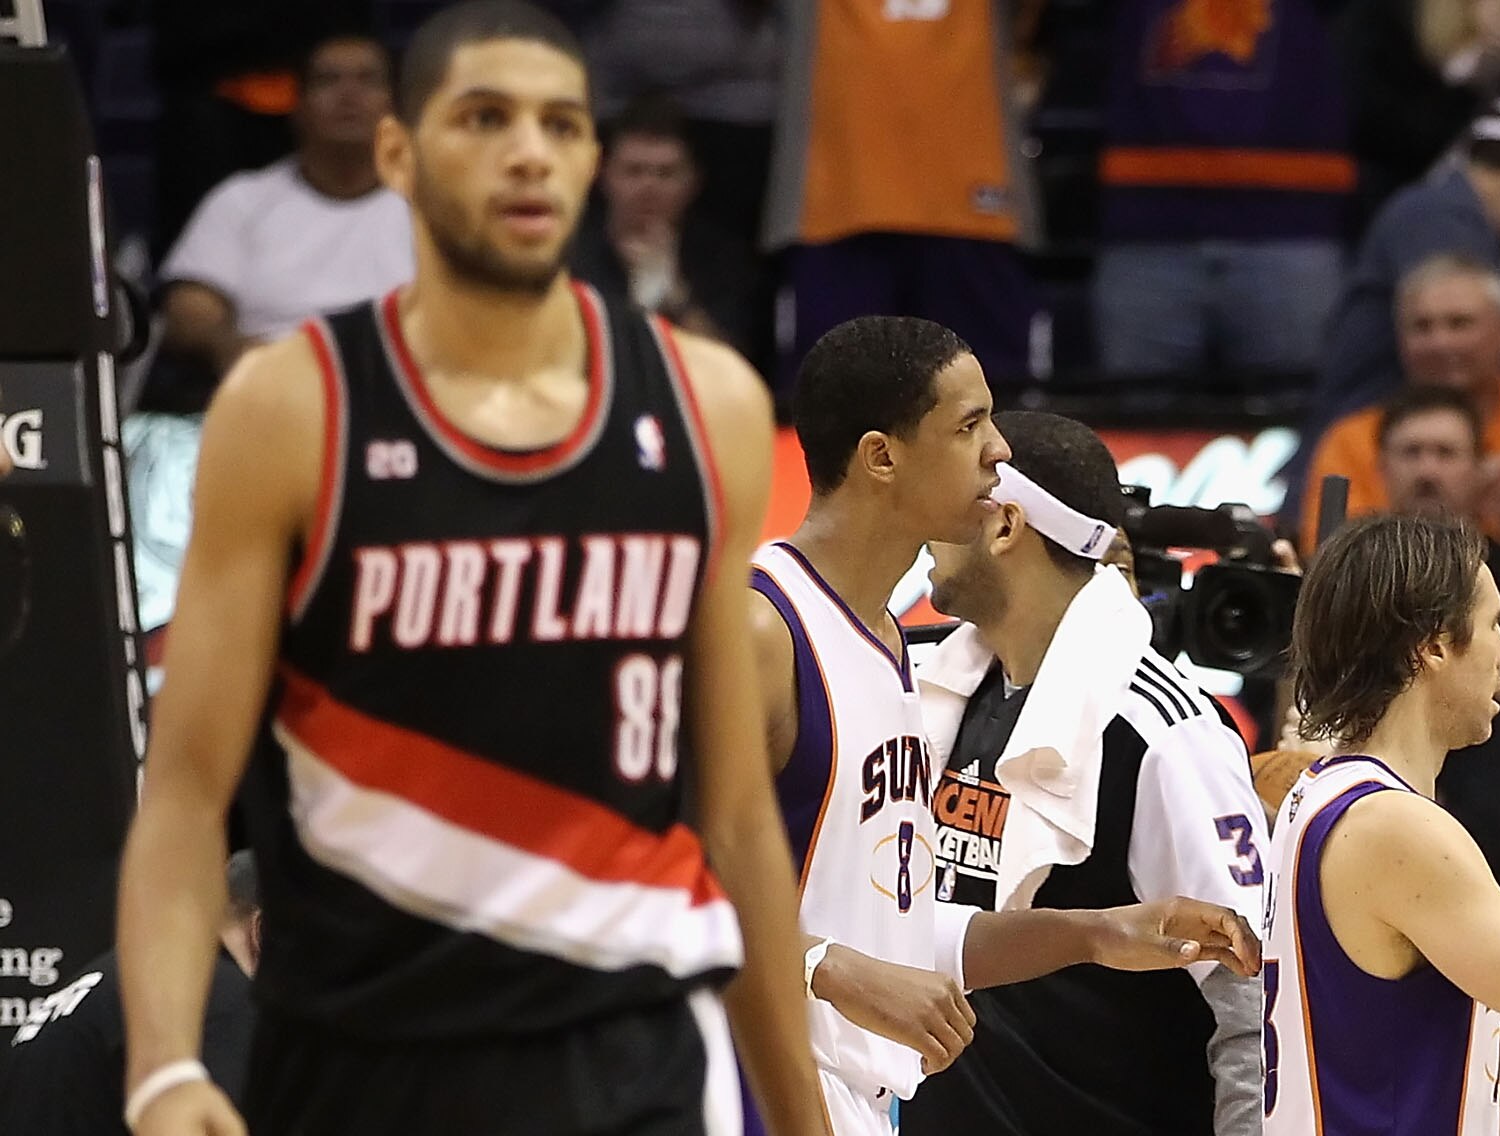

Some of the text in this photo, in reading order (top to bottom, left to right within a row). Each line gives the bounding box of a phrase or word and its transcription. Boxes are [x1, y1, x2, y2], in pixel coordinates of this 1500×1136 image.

[351, 535, 700, 651] PORTLAND
[860, 735, 931, 824] SUN
[1214, 813, 1263, 886] 3
